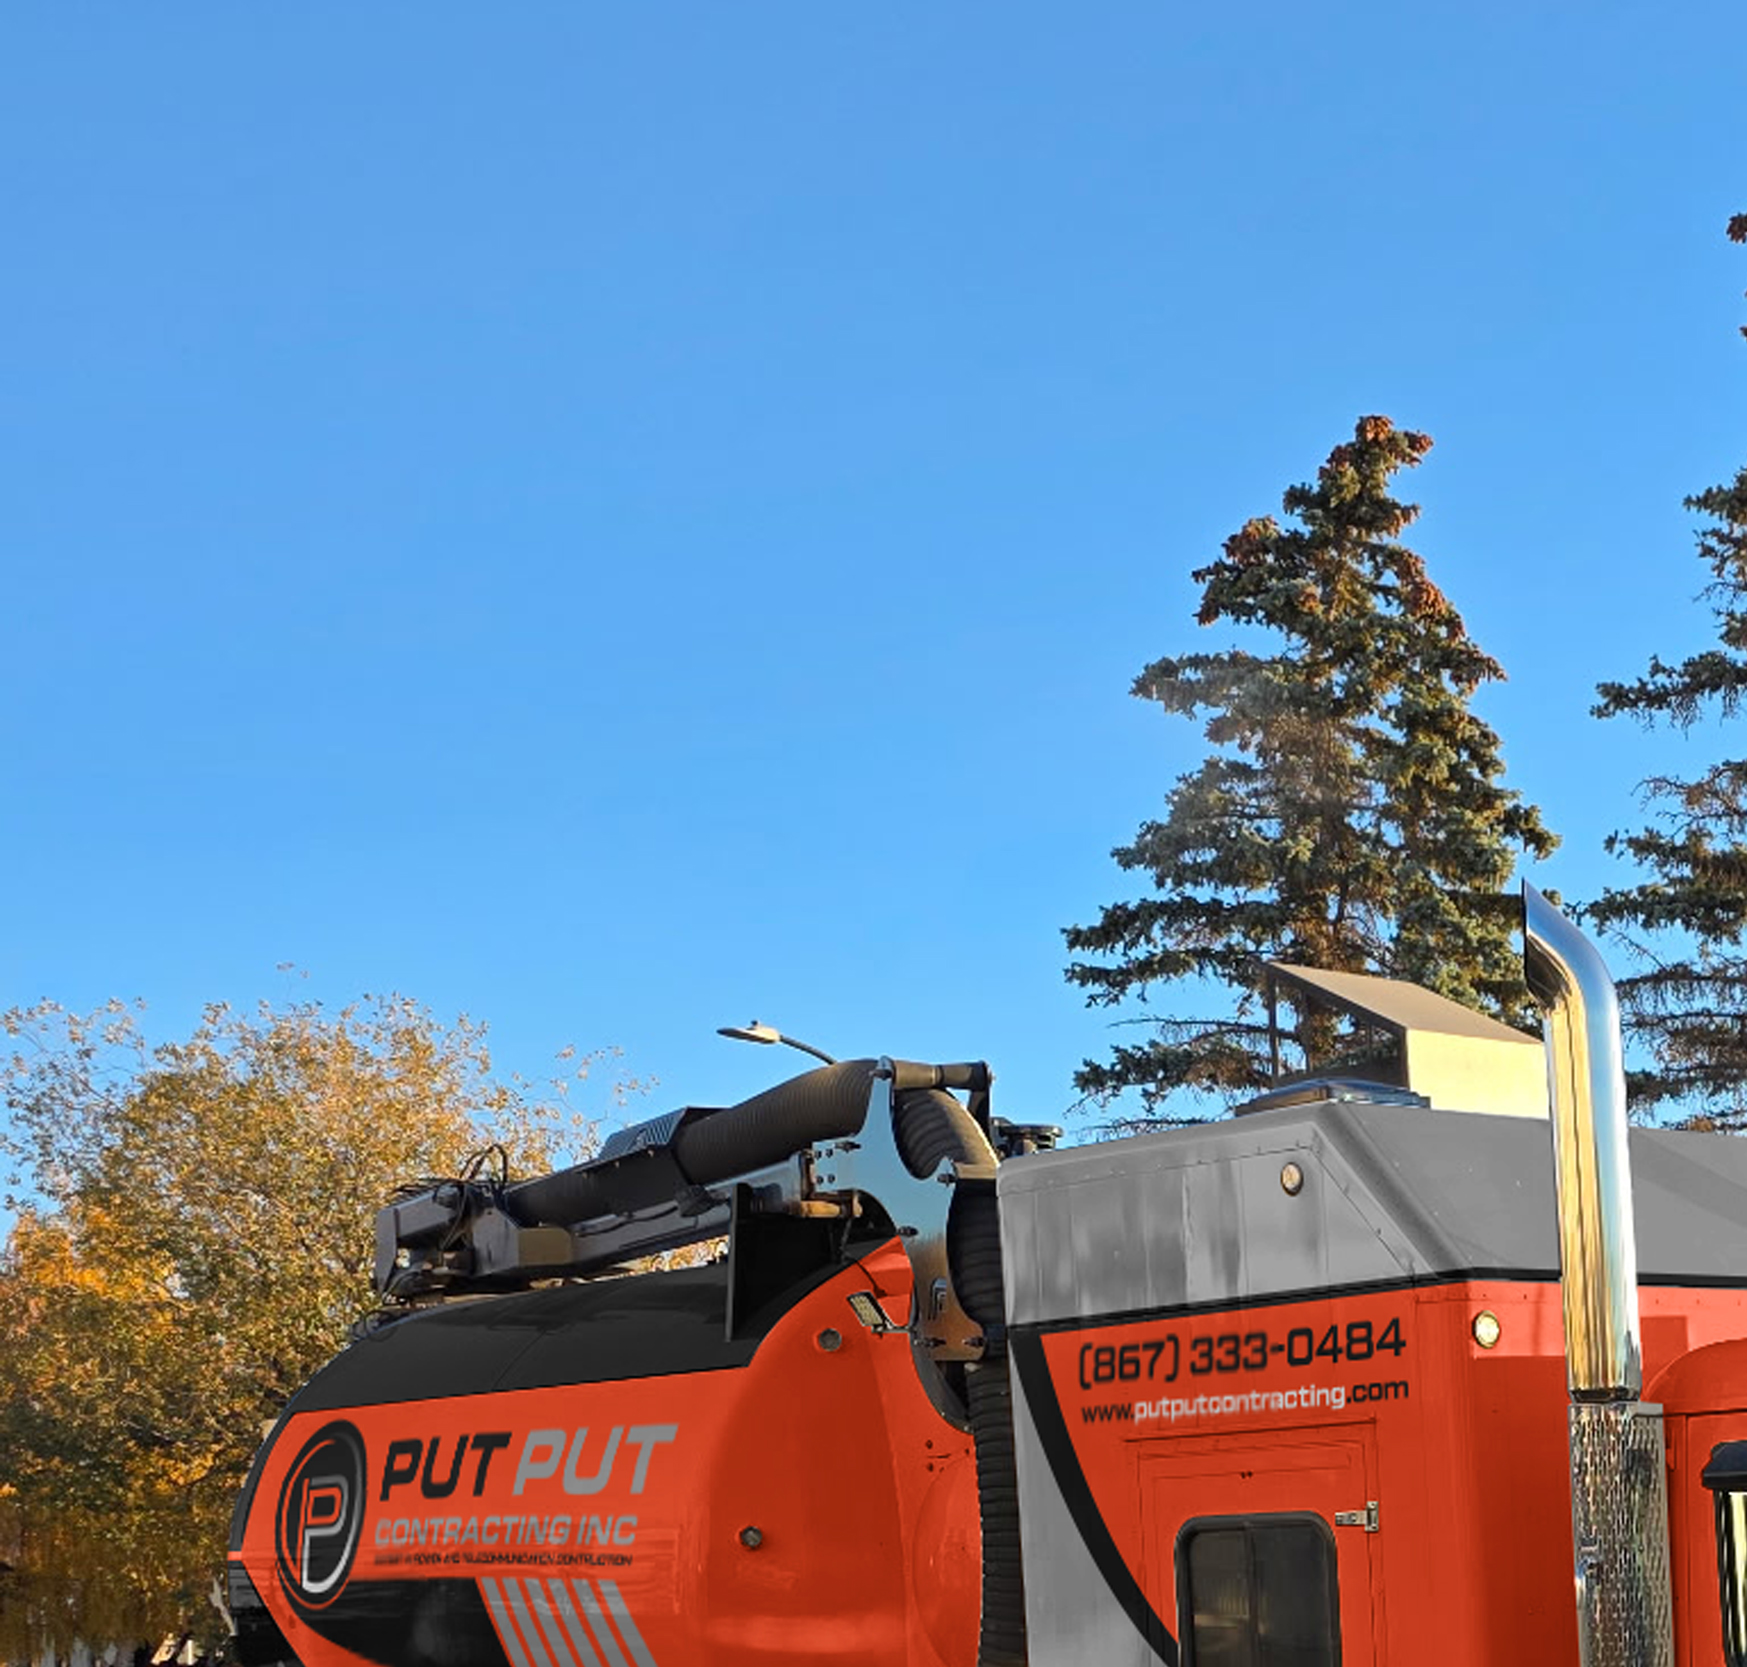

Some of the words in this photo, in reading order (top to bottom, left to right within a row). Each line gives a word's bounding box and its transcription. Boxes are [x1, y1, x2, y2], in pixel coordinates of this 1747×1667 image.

[1079, 1333, 1180, 1390] (867)
[1190, 1317, 1406, 1376] 333-0484
[1081, 1378, 1409, 1424] www.putputcontracting.com
[380, 1432, 512, 1501] PUT
[513, 1423, 678, 1496] PUT
[374, 1514, 572, 1548] CONTRACTING
[577, 1514, 638, 1546] INC
